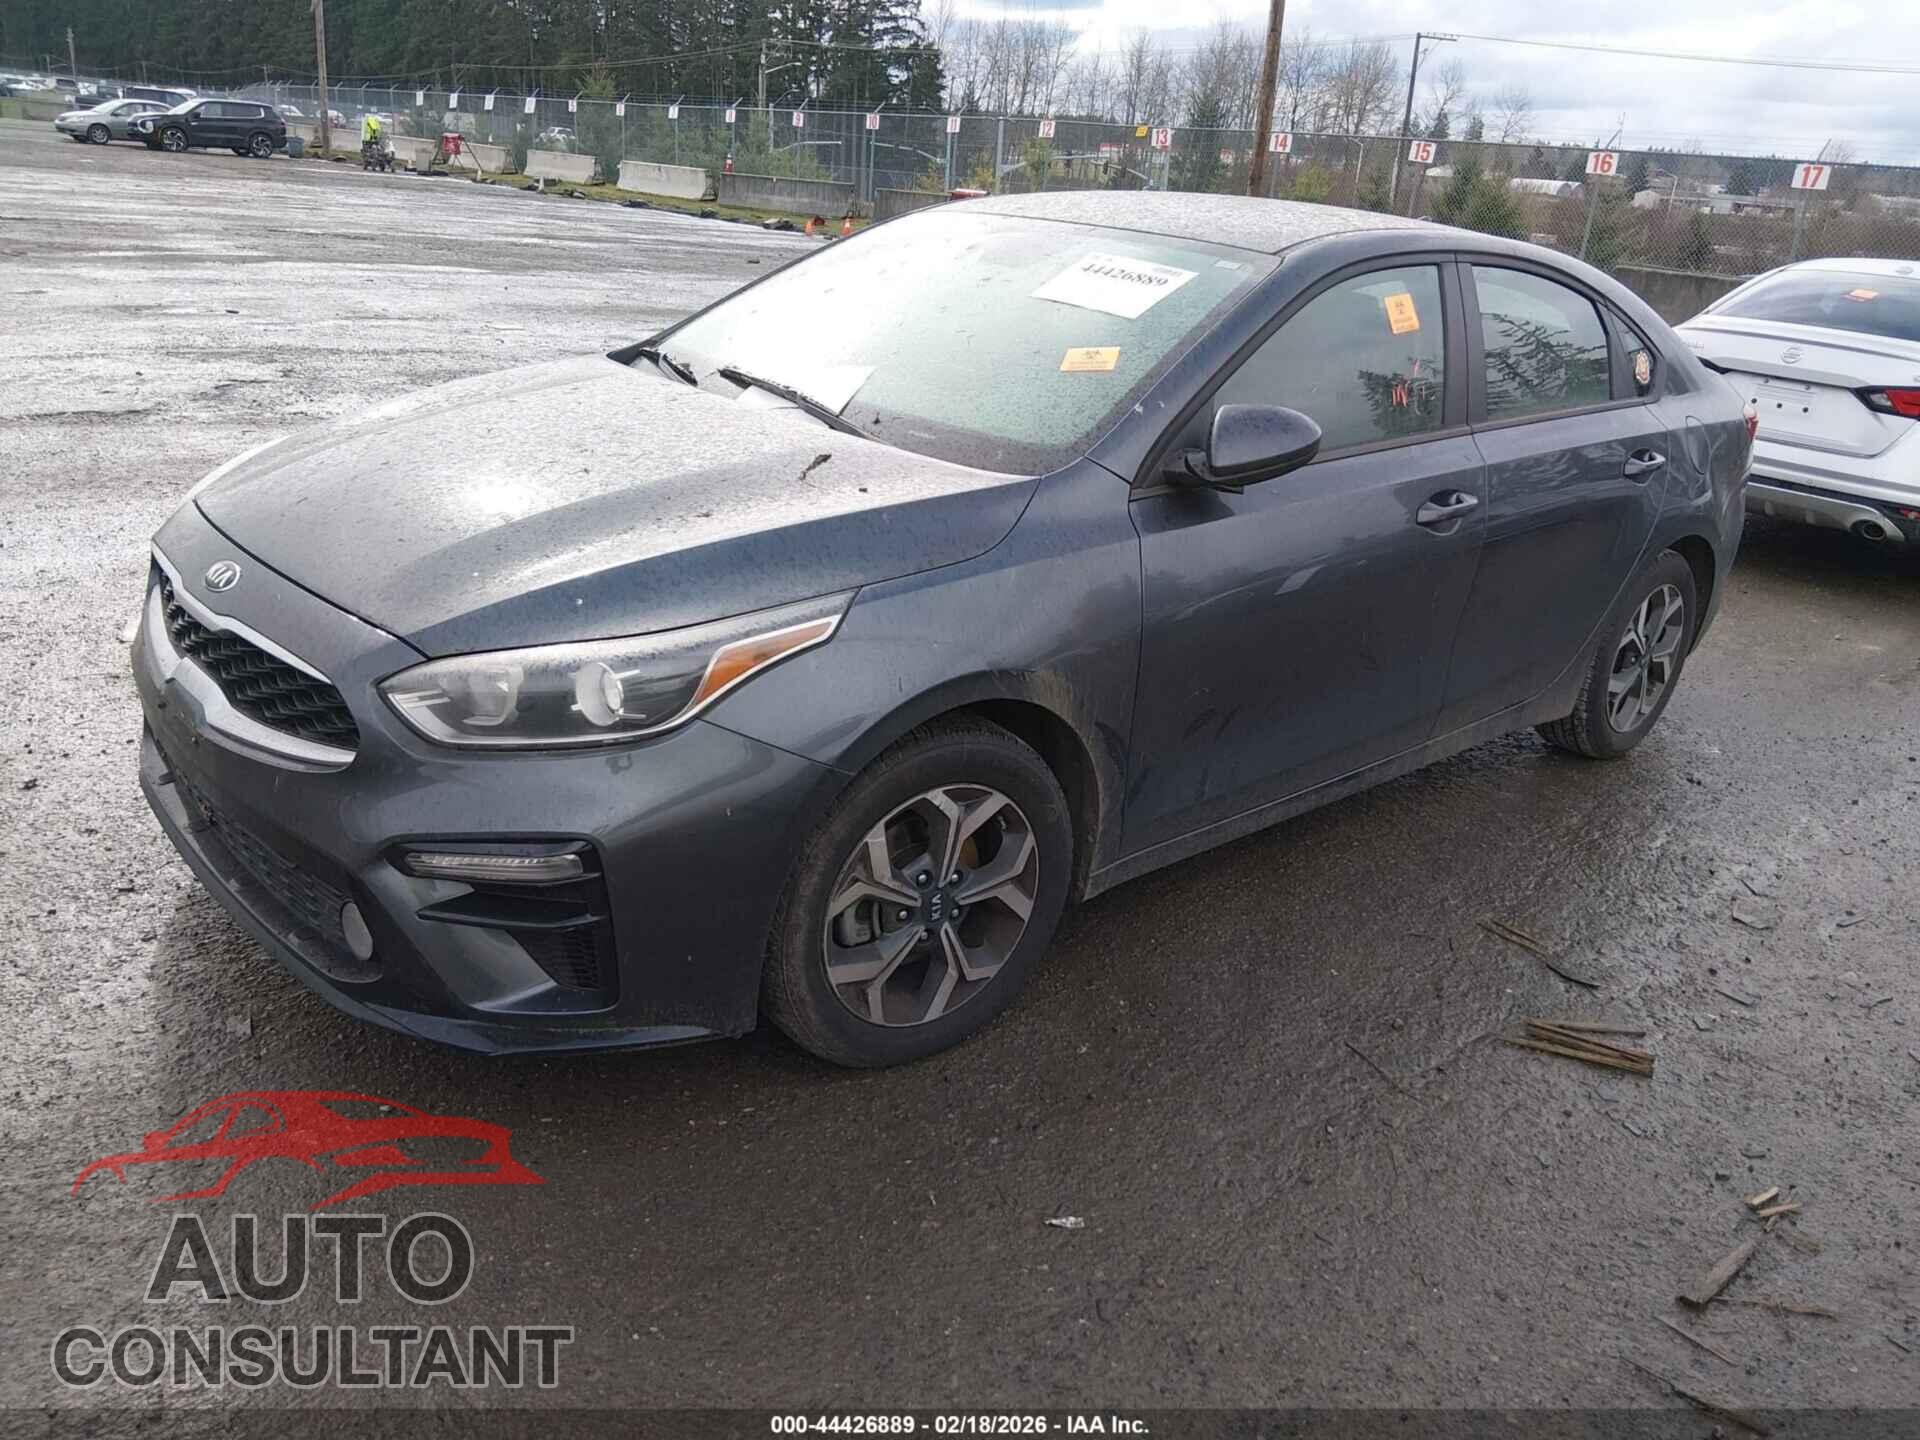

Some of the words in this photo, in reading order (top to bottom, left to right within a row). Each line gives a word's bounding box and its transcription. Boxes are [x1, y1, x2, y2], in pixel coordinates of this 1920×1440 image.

[869, 114, 878, 128] 10
[1042, 120, 1053, 137] 12
[1155, 128, 1168, 146] 13
[1274, 134, 1288, 151] 14
[1414, 142, 1432, 161] 15
[1592, 152, 1614, 173] 16
[1801, 165, 1825, 188] 17
